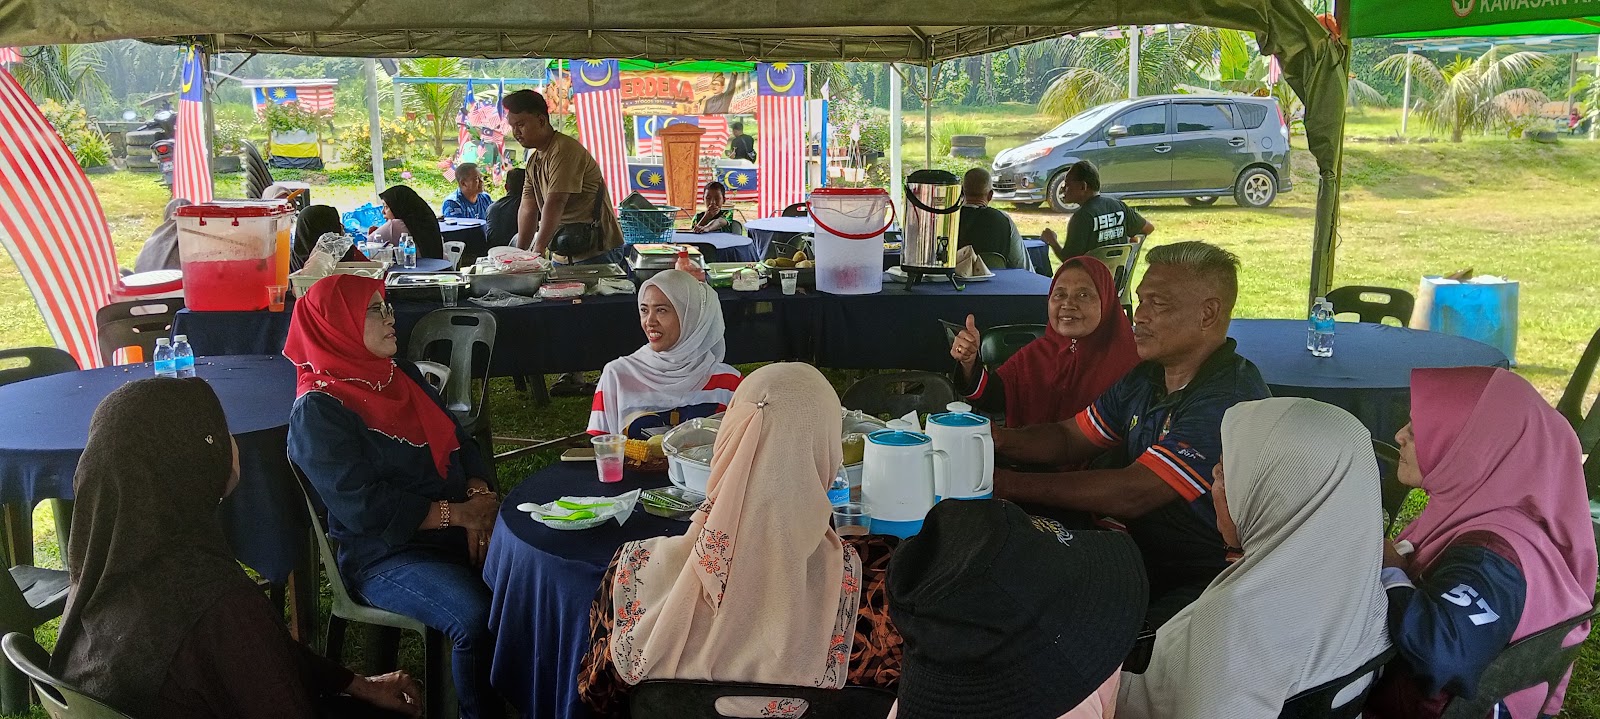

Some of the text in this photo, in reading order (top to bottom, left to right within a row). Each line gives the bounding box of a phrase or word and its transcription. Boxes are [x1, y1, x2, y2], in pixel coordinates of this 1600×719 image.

[621, 77, 695, 101] ERDEKA
[732, 96, 757, 111] MERDEK
[1093, 211, 1125, 231] 1957
[1441, 584, 1500, 626] 57
